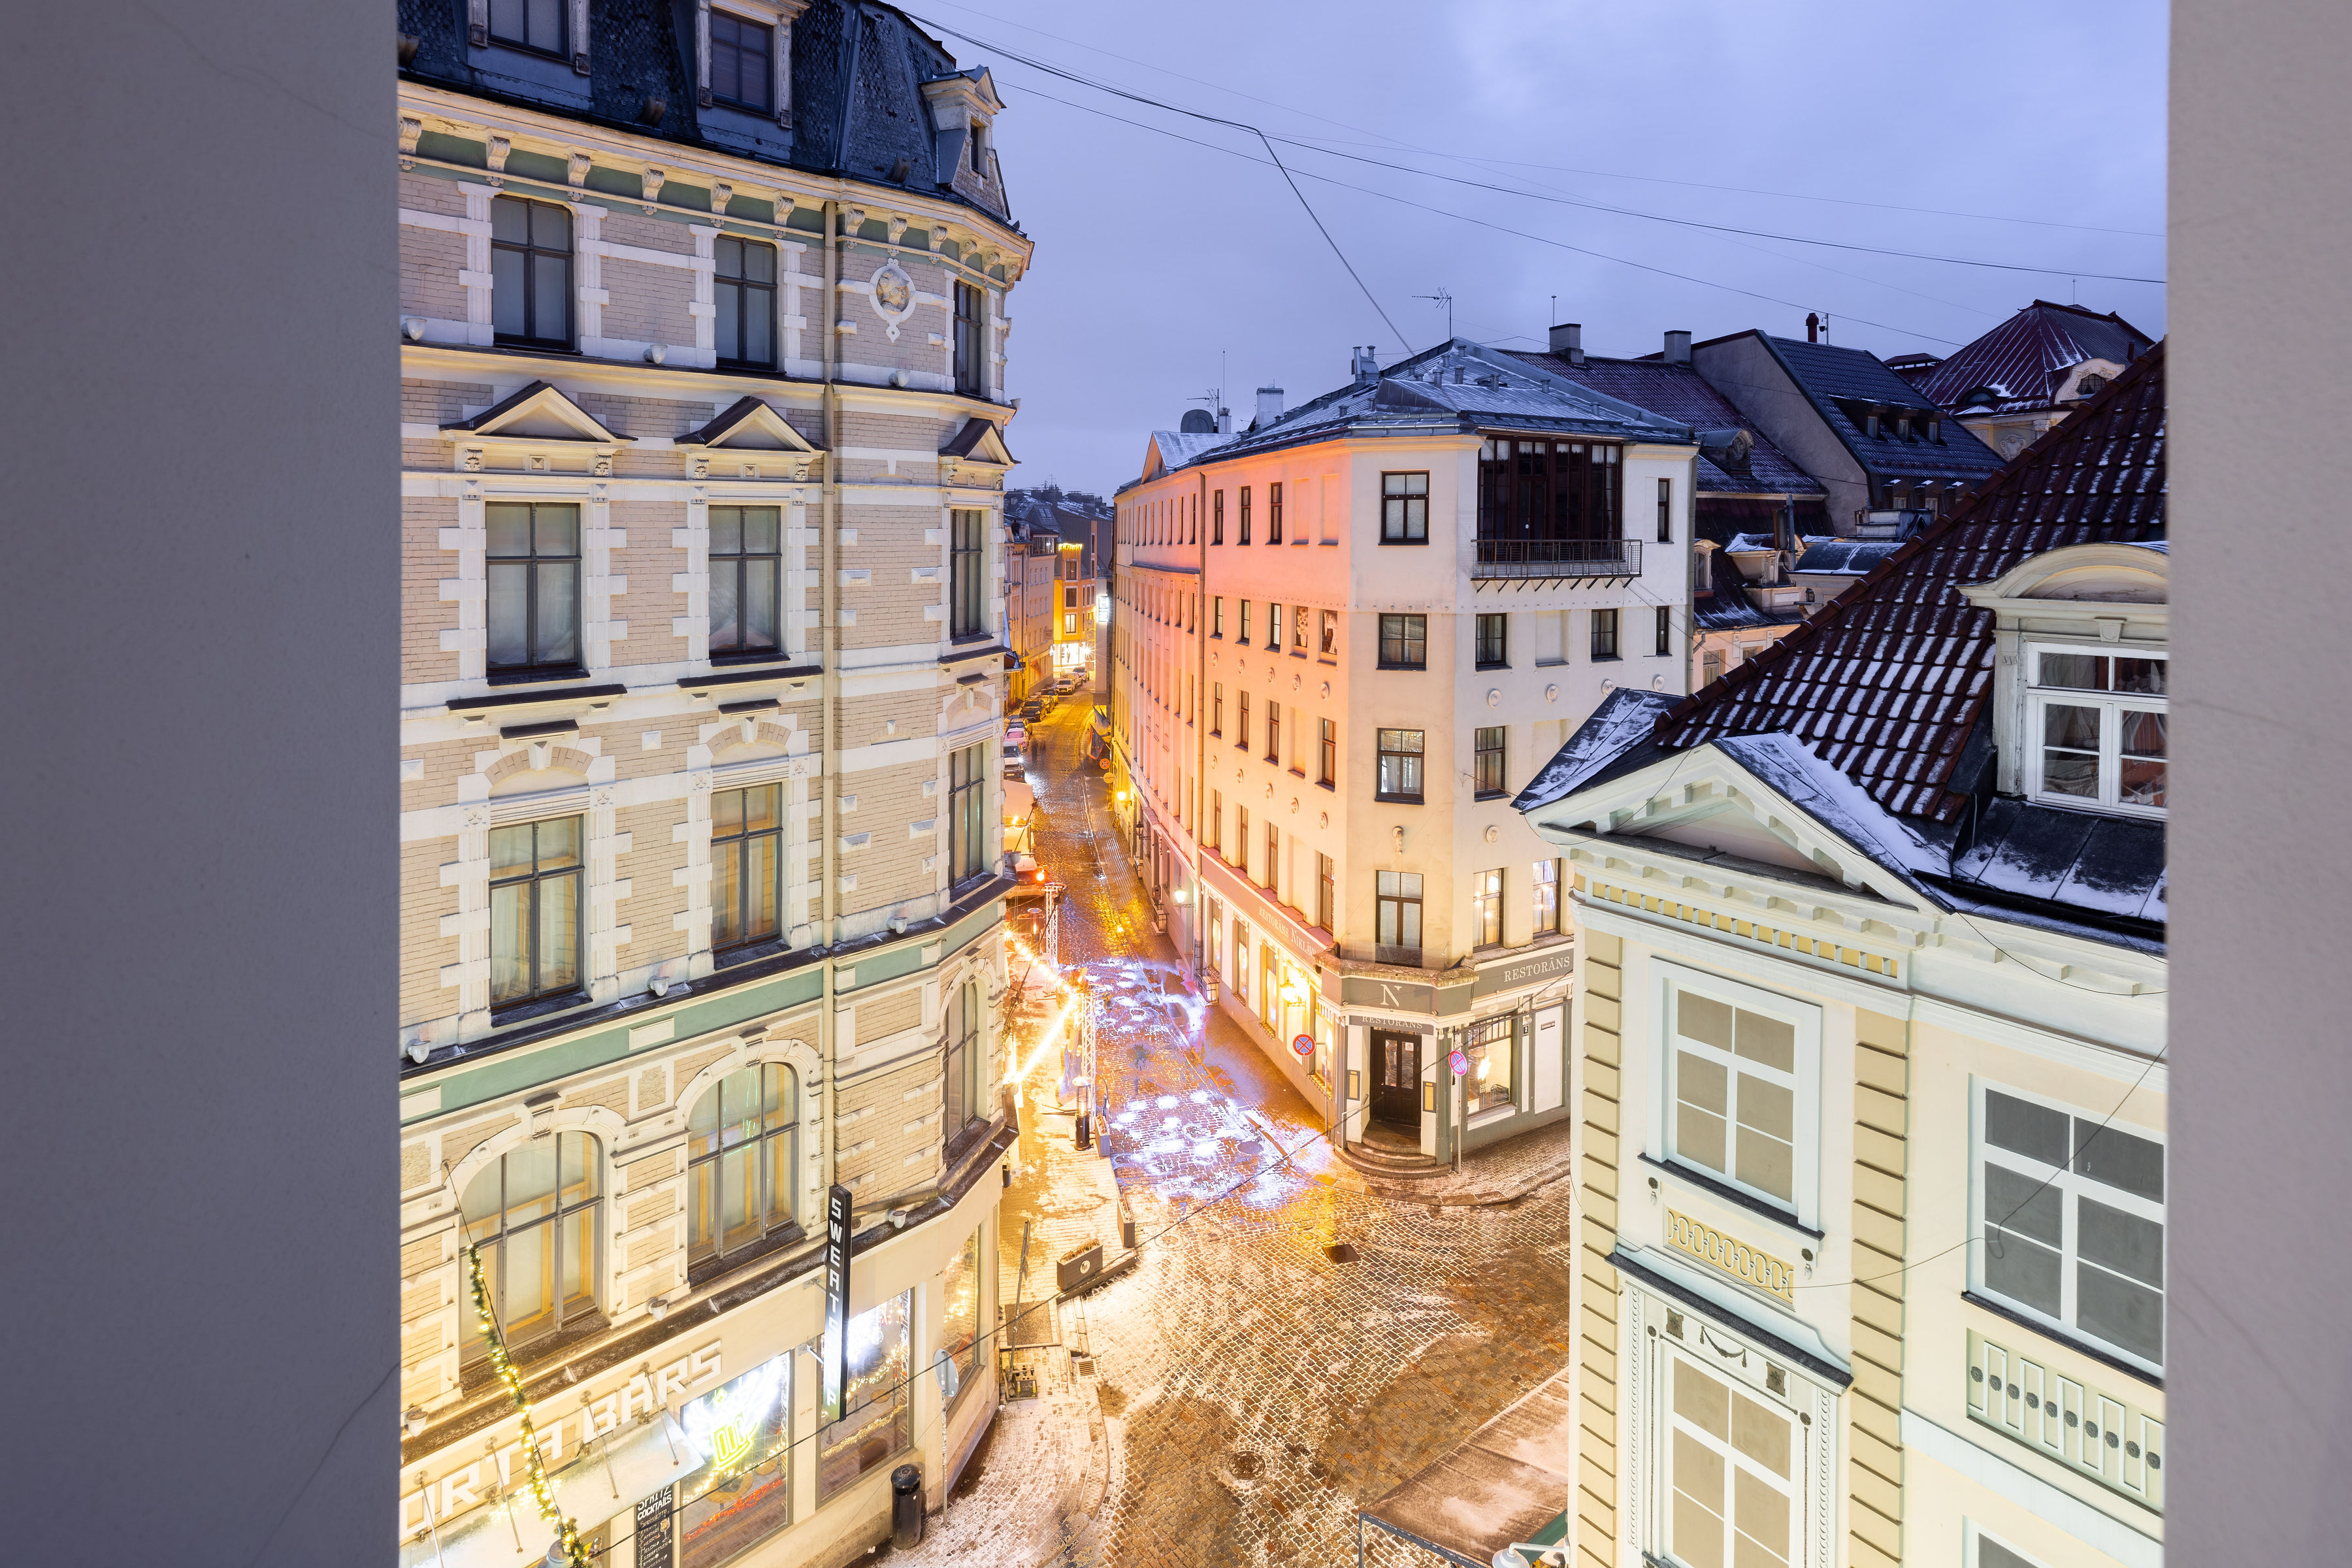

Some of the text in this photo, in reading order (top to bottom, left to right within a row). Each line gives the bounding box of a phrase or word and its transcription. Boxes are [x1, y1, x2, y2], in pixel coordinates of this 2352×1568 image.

[1503, 956, 1570, 982] RESTORĀNS
[1380, 983, 1403, 1007] N
[583, 1340, 722, 1444] BARS
[637, 1494, 672, 1521] COCKTAILS
